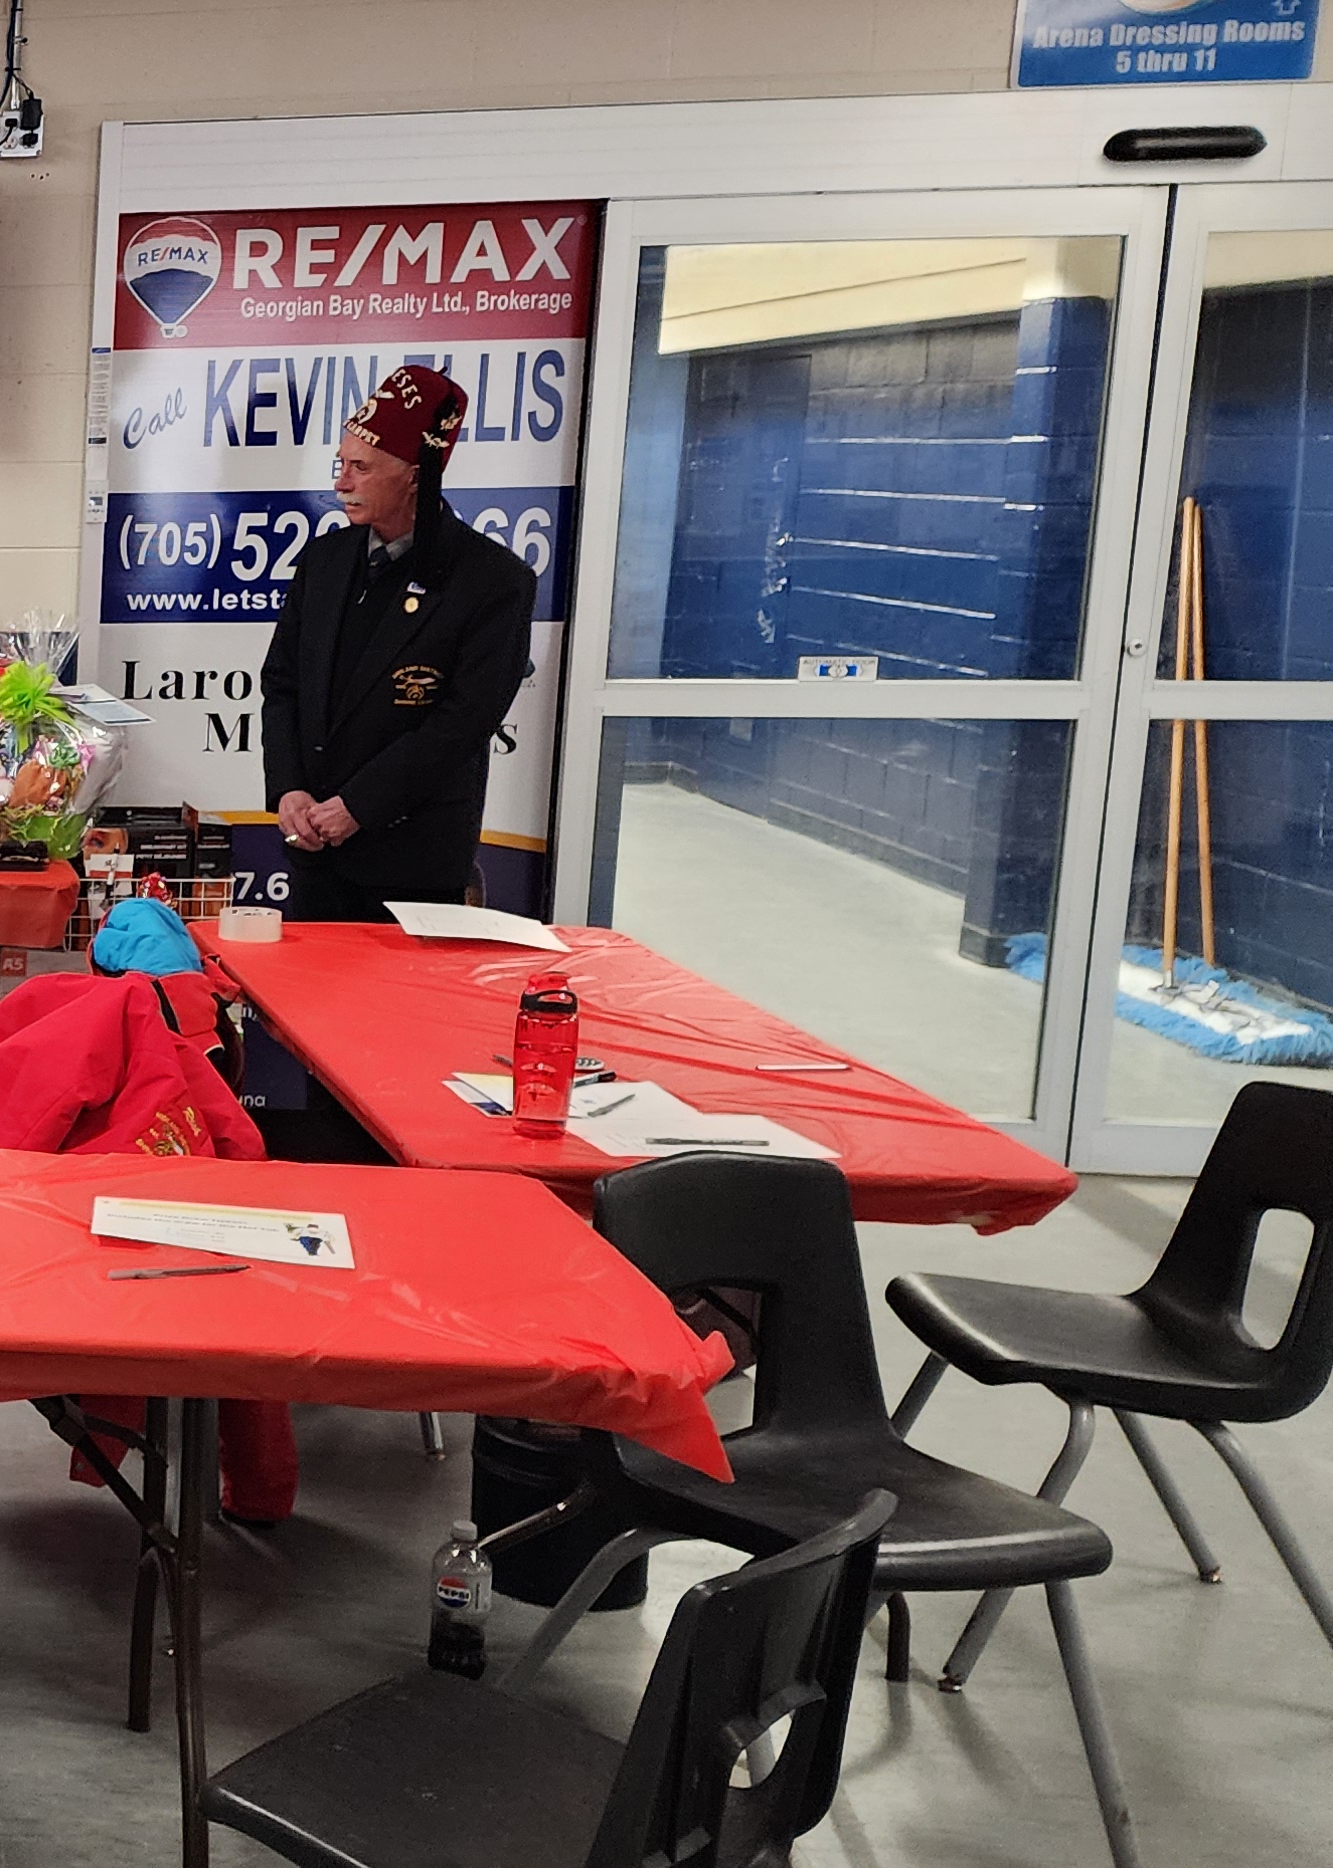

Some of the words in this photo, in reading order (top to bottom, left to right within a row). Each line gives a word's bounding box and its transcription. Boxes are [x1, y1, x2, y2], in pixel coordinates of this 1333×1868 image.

[1033, 25, 1104, 49] Arena
[1109, 21, 1218, 47] Dressing
[1223, 19, 1306, 42] Rooms
[1115, 50, 1131, 74] 5
[1136, 50, 1188, 73] thru
[1194, 47, 1217, 72] 11
[136, 245, 210, 268] RE/MAX
[234, 216, 574, 290] RE/MAX
[240, 296, 324, 320] Georgian
[328, 294, 364, 320] Bay
[367, 293, 428, 319] Realty
[475, 290, 574, 318] Brokerage
[122, 386, 188, 451] Call
[203, 354, 378, 448] KEVIN
[119, 512, 222, 571] (705)
[121, 660, 259, 701] Laro
[233, 871, 291, 902] 7.6
[438, 1585, 470, 1600] PEPSI
